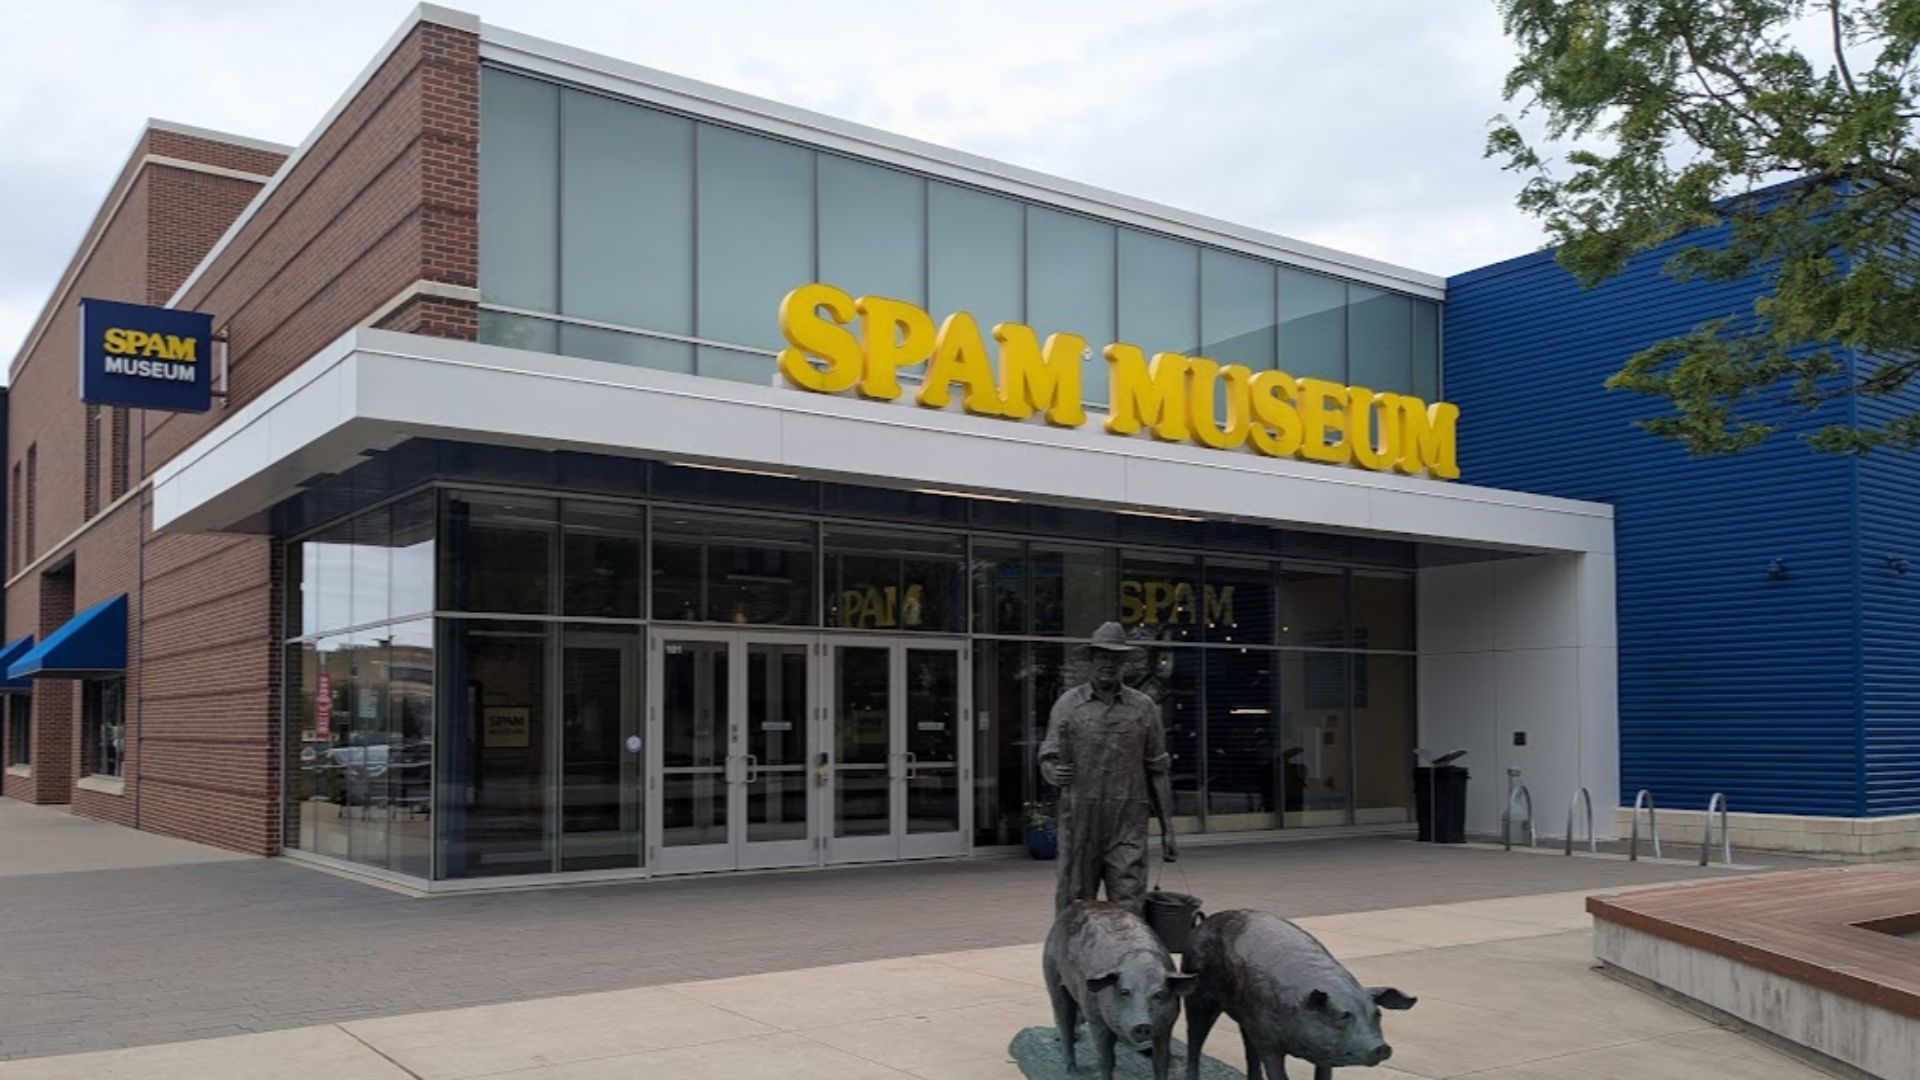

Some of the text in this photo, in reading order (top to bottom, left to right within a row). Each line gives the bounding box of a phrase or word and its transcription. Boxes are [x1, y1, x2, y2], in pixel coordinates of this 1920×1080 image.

[104, 327, 196, 362] SPAM
[105, 356, 195, 382] MUSEUM
[778, 283, 1460, 480] SPAM MUSEUM
[831, 584, 924, 628] PAM
[1120, 580, 1236, 625] SPAM
